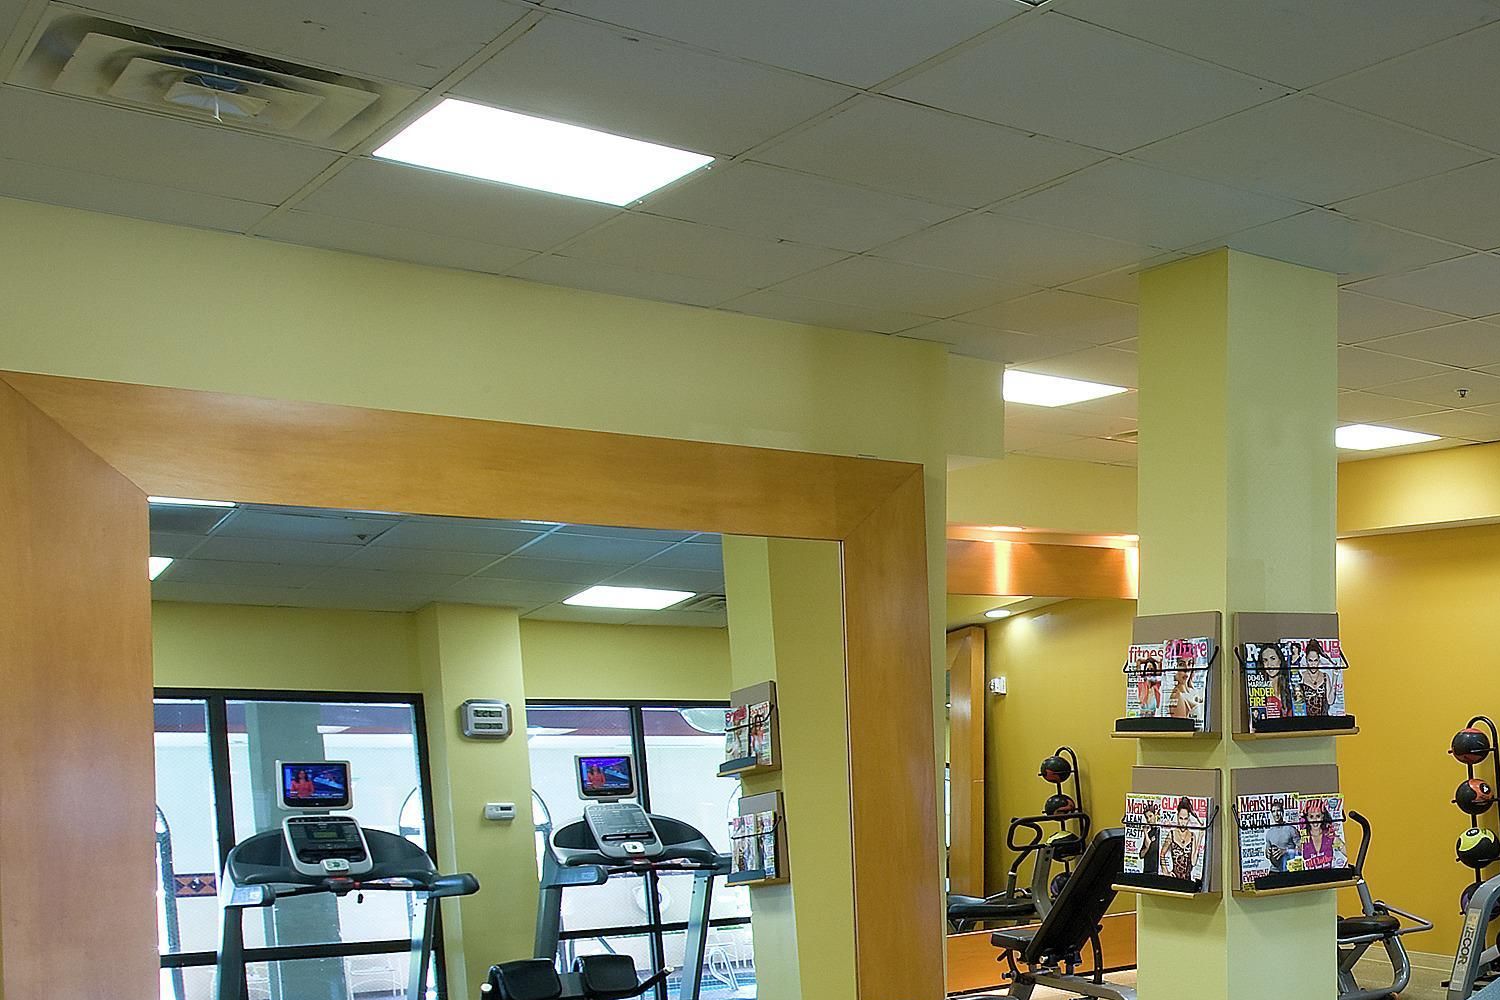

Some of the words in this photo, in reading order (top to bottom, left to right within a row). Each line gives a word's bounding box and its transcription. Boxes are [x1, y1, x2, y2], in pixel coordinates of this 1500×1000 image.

[1129, 646, 1164, 664] fitnes
[1165, 639, 1207, 659] allure
[1249, 687, 1275, 697] UNDER
[1249, 697, 1266, 706] FIRE
[1161, 796, 1207, 812] GLAUR
[1457, 916, 1477, 965] ECOR
